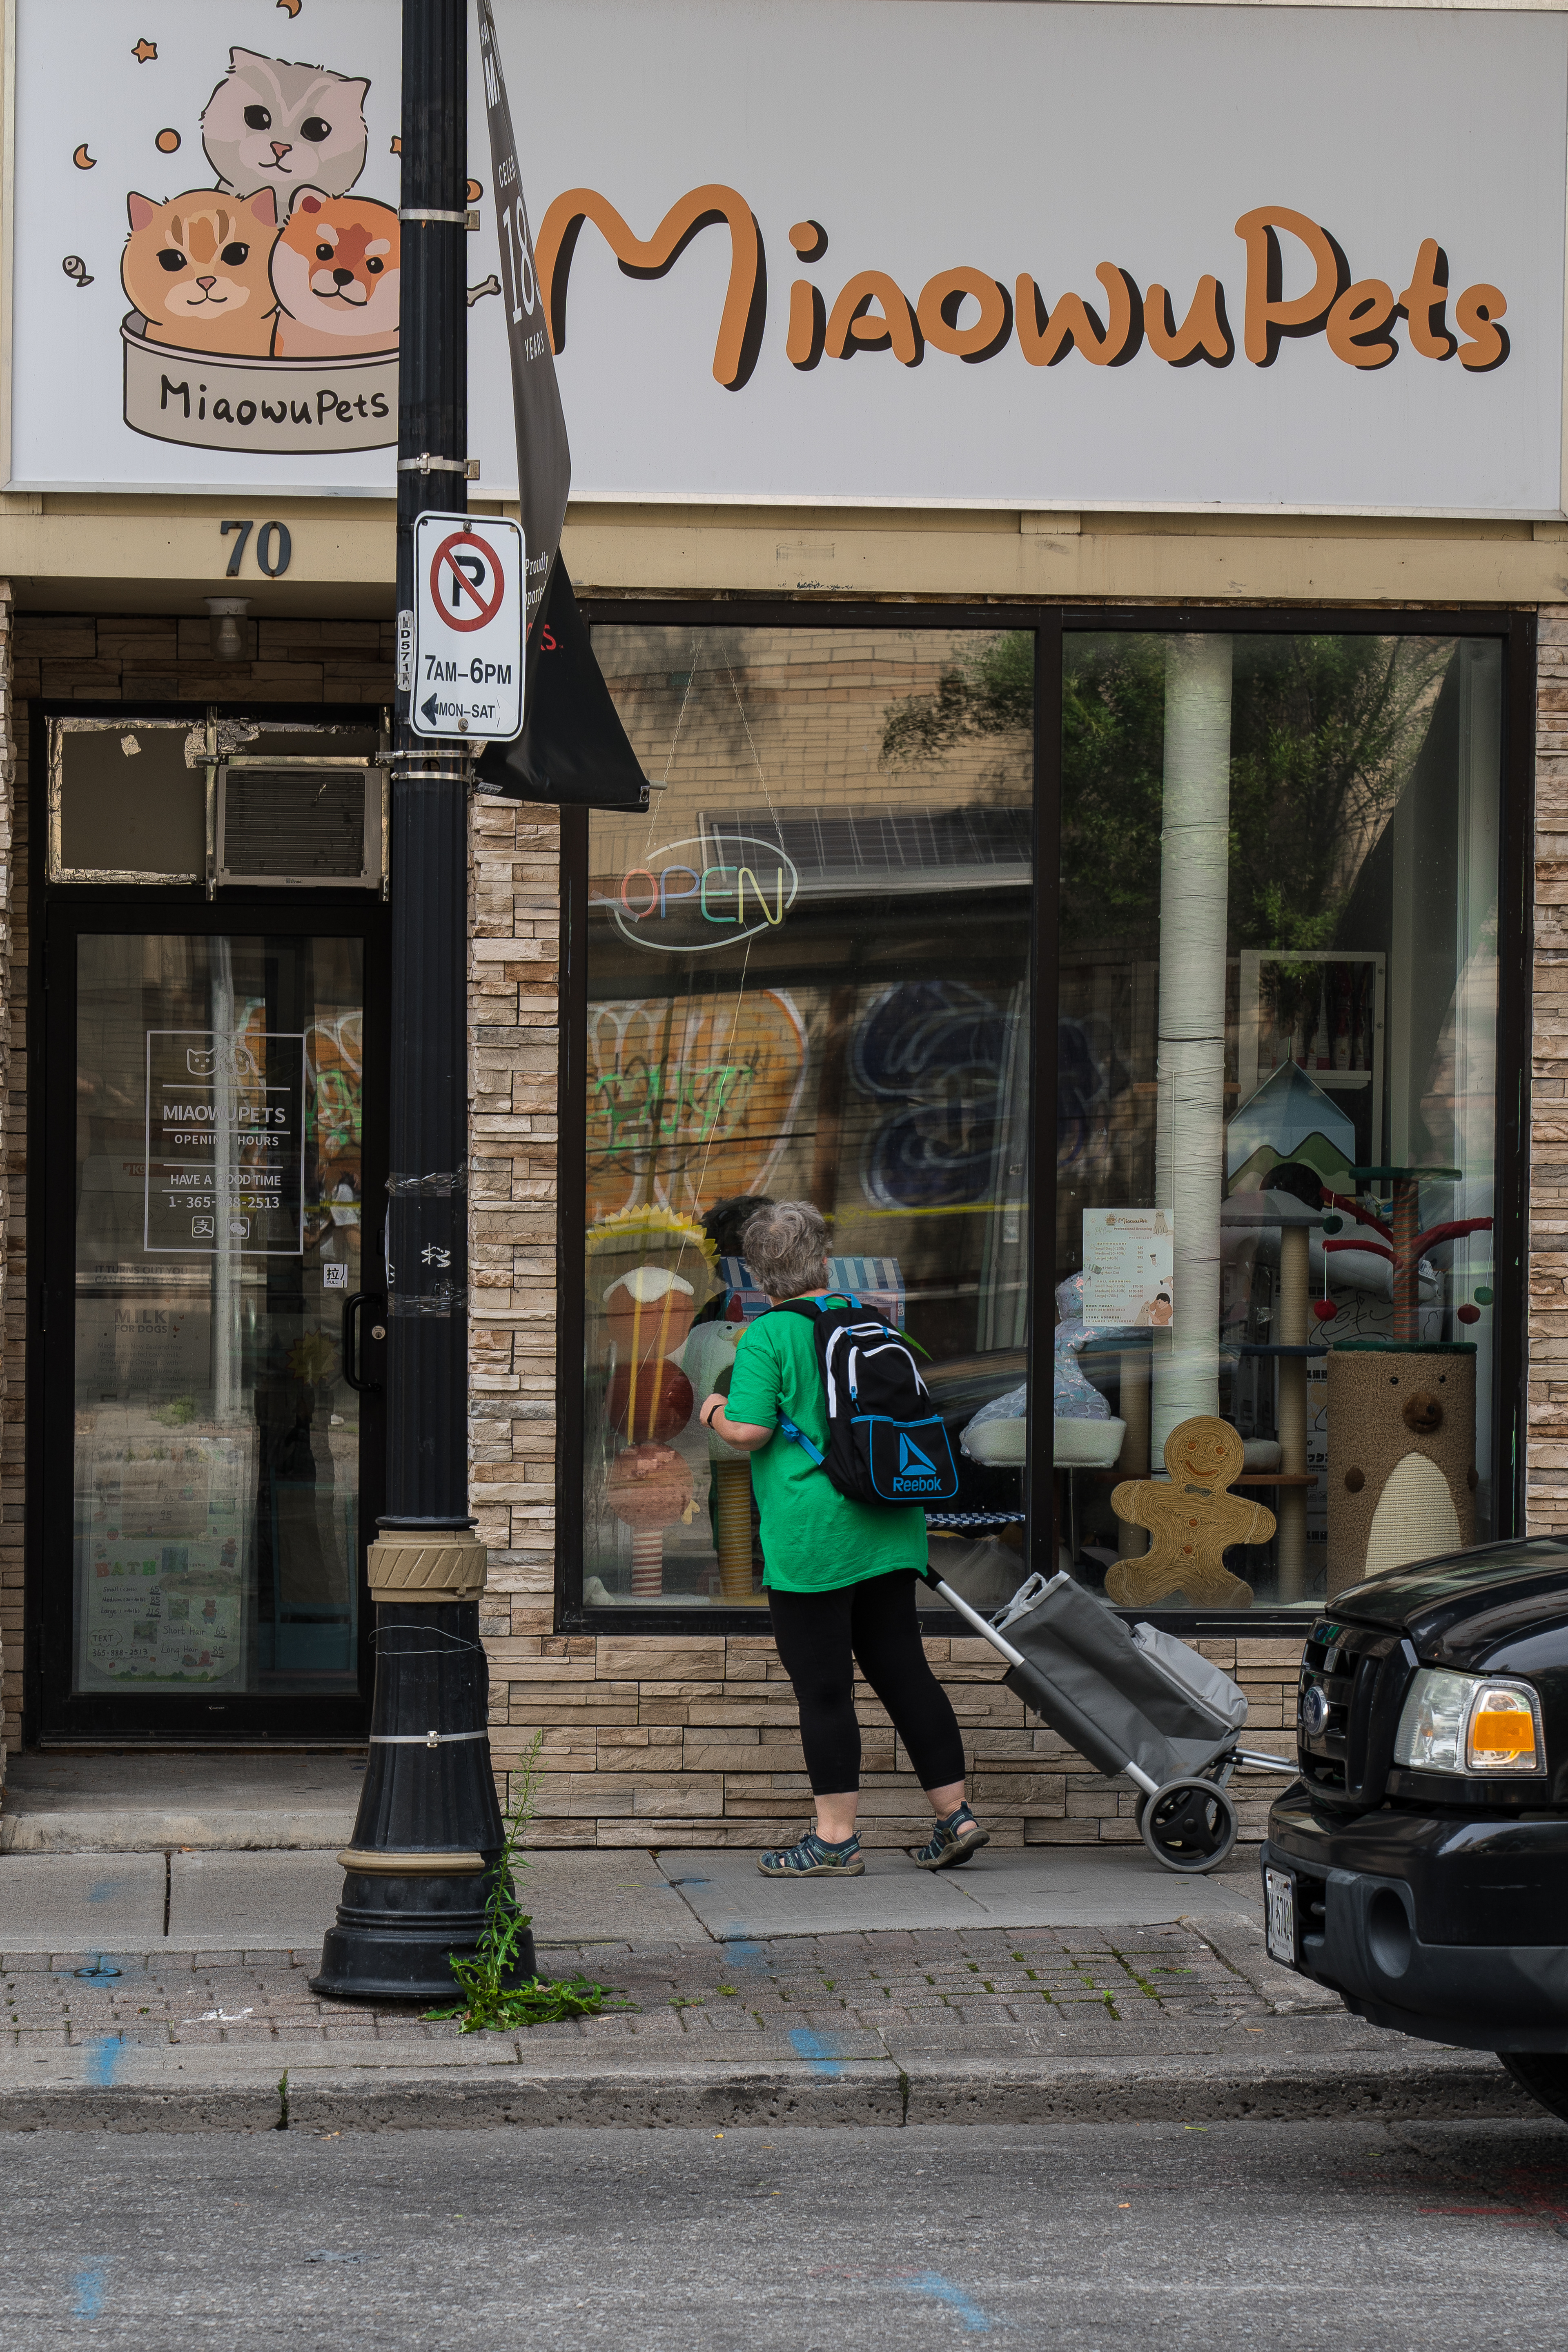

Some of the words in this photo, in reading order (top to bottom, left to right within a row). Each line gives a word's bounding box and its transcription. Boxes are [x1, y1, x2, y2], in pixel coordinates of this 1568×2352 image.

[525, 330, 544, 362] YEARS
[160, 375, 389, 425] MiaowuPets
[220, 521, 291, 577] 70
[526, 551, 549, 577] Proudly
[452, 555, 486, 606] P
[400, 630, 411, 672] D571
[425, 654, 512, 684] 7AM-6PM
[439, 702, 495, 719] MON-SAT
[621, 865, 783, 924] OPEN
[164, 1105, 285, 1123] MIAOWUPETS
[174, 1134, 230, 1145] OPENING
[237, 1136, 278, 1146] HOURS
[133, 1165, 146, 1175] K9
[171, 1174, 200, 1185] HAVE
[204, 1174, 212, 1185] A
[216, 1174, 251, 1185] GOOD
[253, 1175, 281, 1186] TIME
[186, 1196, 279, 1209] 365-888-2513
[95, 1265, 104, 1273] IT
[105, 1265, 140, 1274] TURNS
[142, 1266, 165, 1274] OUT
[165, 1267, 188, 1275] YOU
[327, 1267, 339, 1280] 拉
[94, 1276, 116, 1284] CAN
[115, 1308, 168, 1324] MILK
[115, 1324, 135, 1332] FOR
[138, 1325, 168, 1334] DOGS
[892, 1477, 942, 1492] Reebok
[161, 1509, 172, 1519] 95
[95, 1561, 157, 1578] BATH
[100, 1608, 117, 1618] Large
[163, 1626, 185, 1635] Short
[189, 1627, 207, 1636] Hair
[216, 1626, 226, 1636] 65
[92, 1649, 149, 1657] 365-888-2513
[161, 1646, 180, 1661] Long
[212, 1646, 224, 1655] 85
